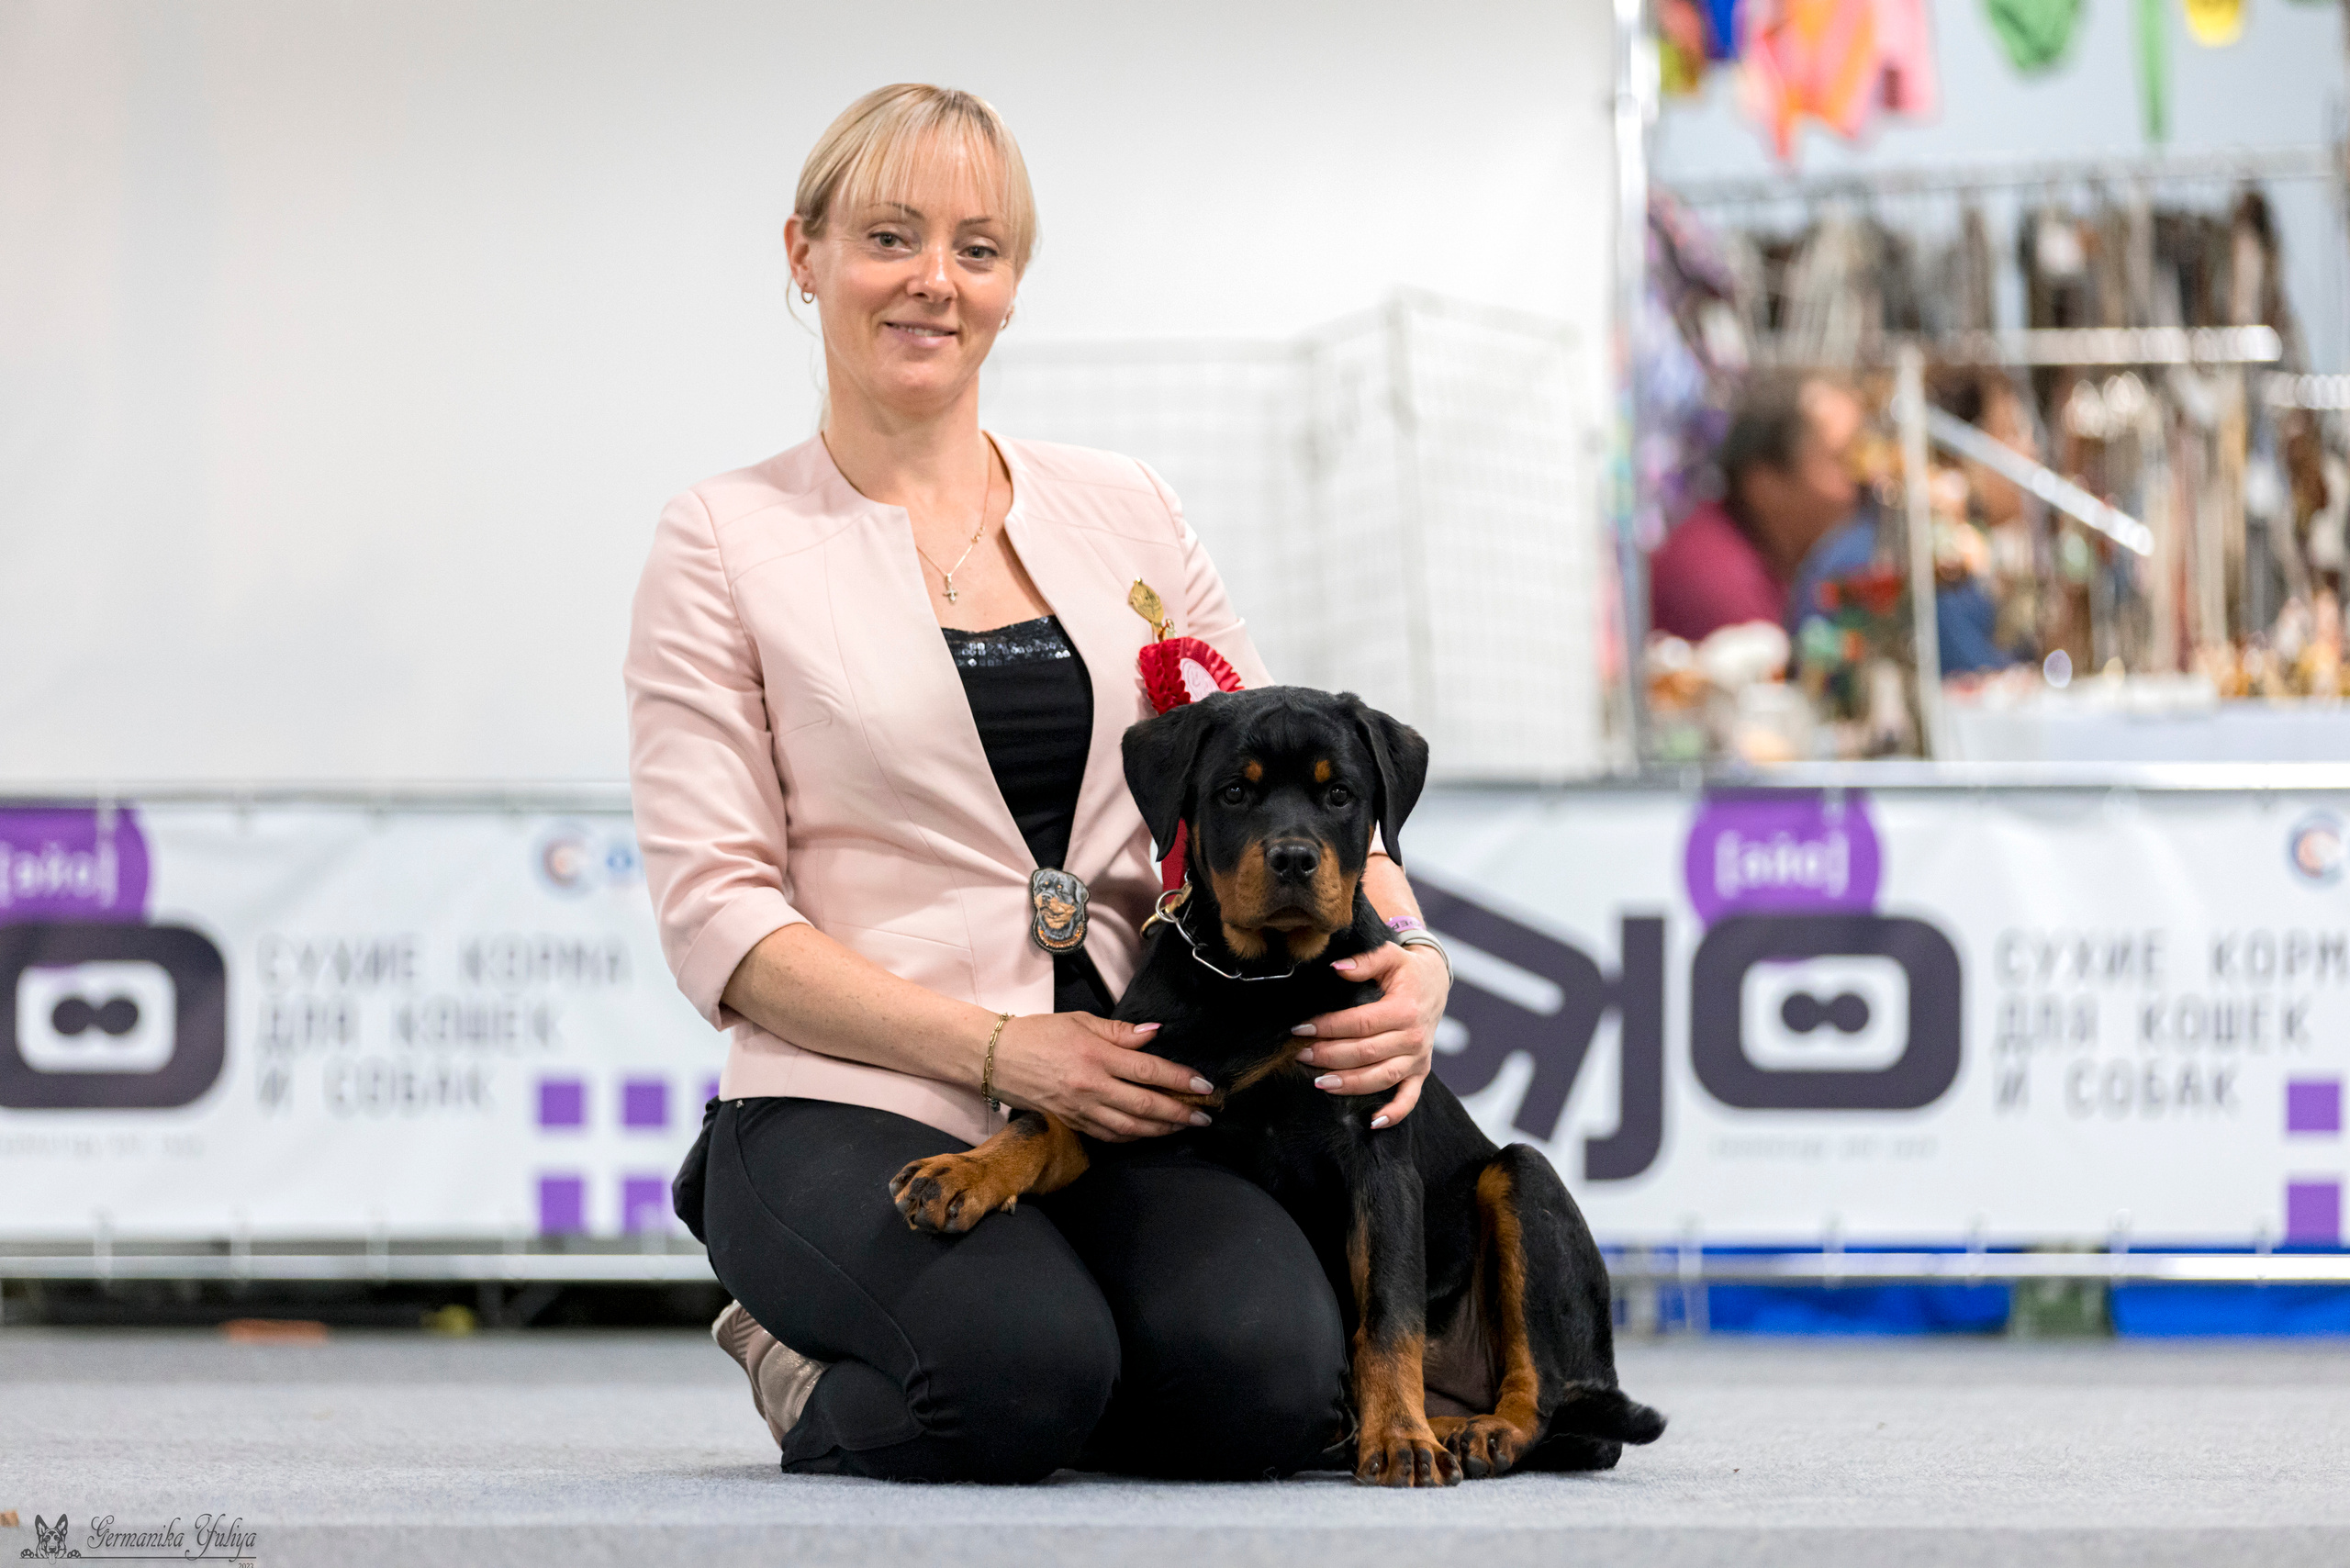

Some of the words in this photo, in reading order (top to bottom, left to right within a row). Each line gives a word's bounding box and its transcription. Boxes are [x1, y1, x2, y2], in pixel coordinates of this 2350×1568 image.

[1996, 931, 2166, 986] СУХИЕ
[1994, 995, 2099, 1056] ДЛЯ
[2140, 996, 2309, 1052] КОШЕК
[2065, 1061, 2237, 1118] СОБАК
